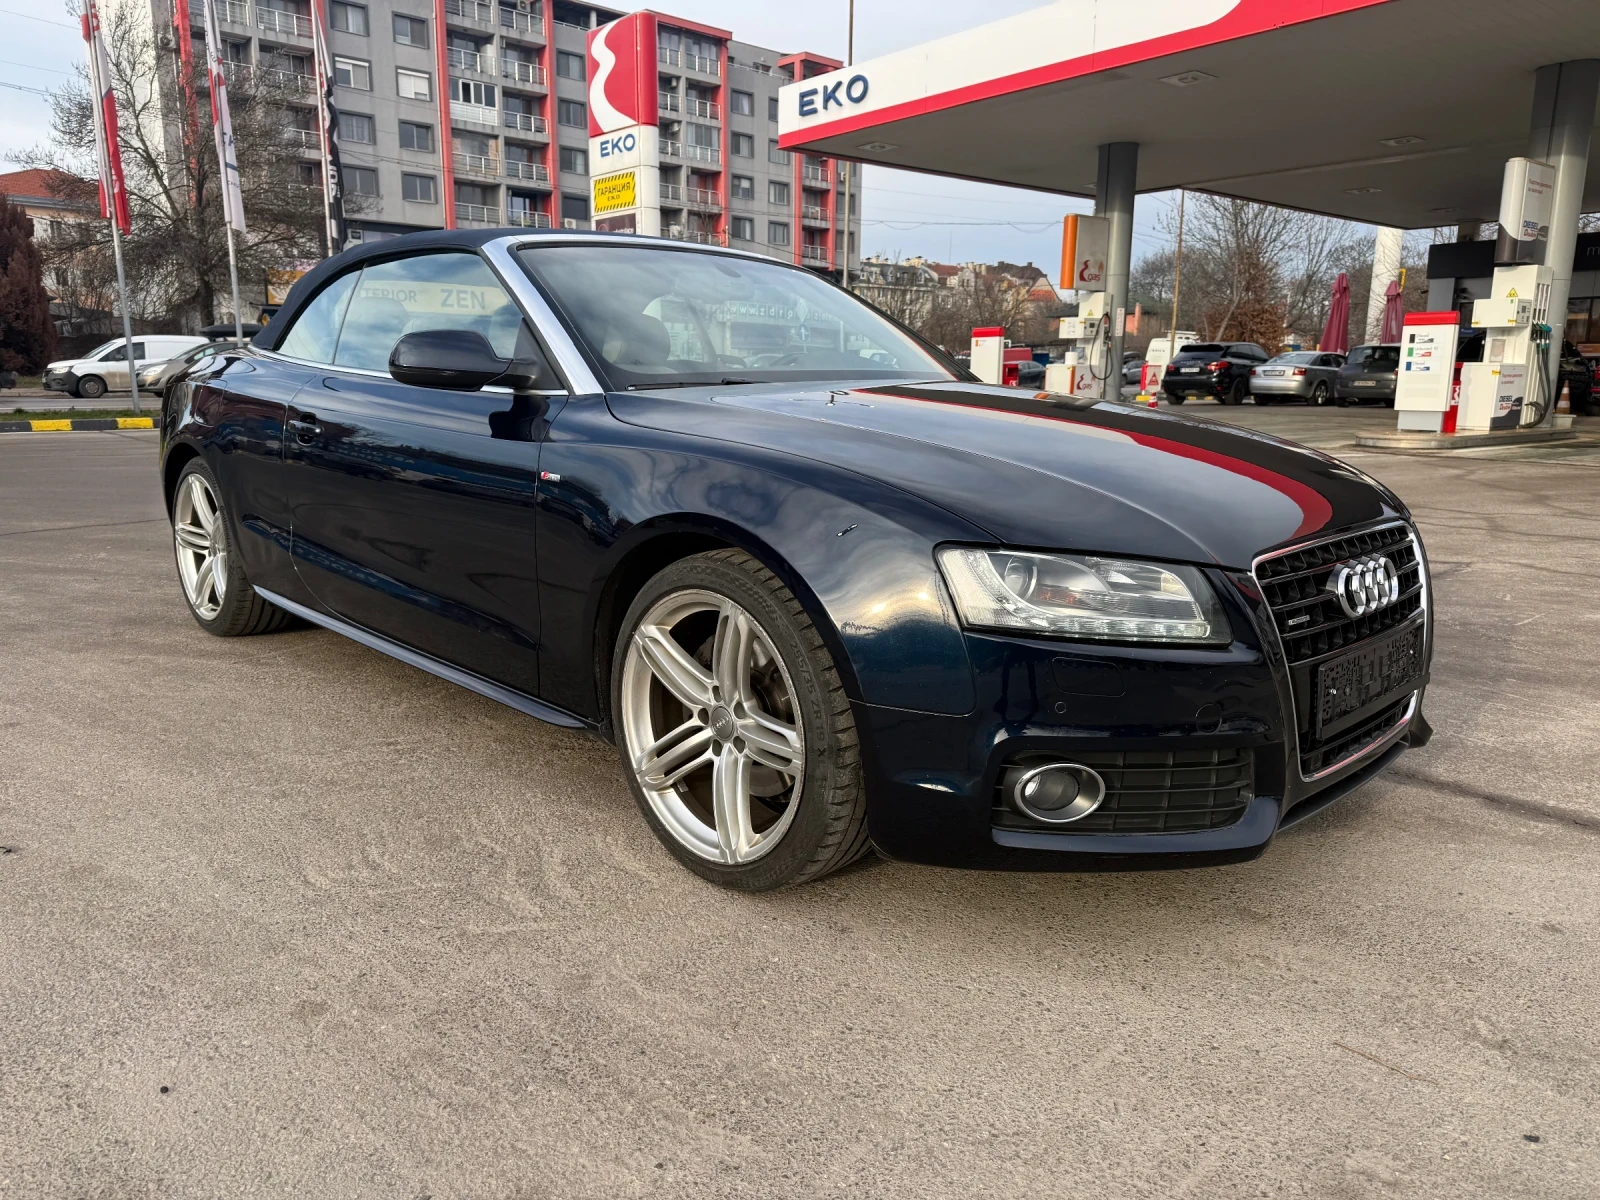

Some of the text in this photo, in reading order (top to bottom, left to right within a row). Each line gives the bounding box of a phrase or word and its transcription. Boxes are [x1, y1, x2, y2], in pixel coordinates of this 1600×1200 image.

[798, 74, 870, 118] EKO
[600, 133, 636, 158] EKO
[597, 181, 631, 197] ГАРАНЦИЯ
[1088, 273, 1101, 283] gas
[440, 288, 486, 311] ZEN
[789, 640, 817, 696] 255/35
